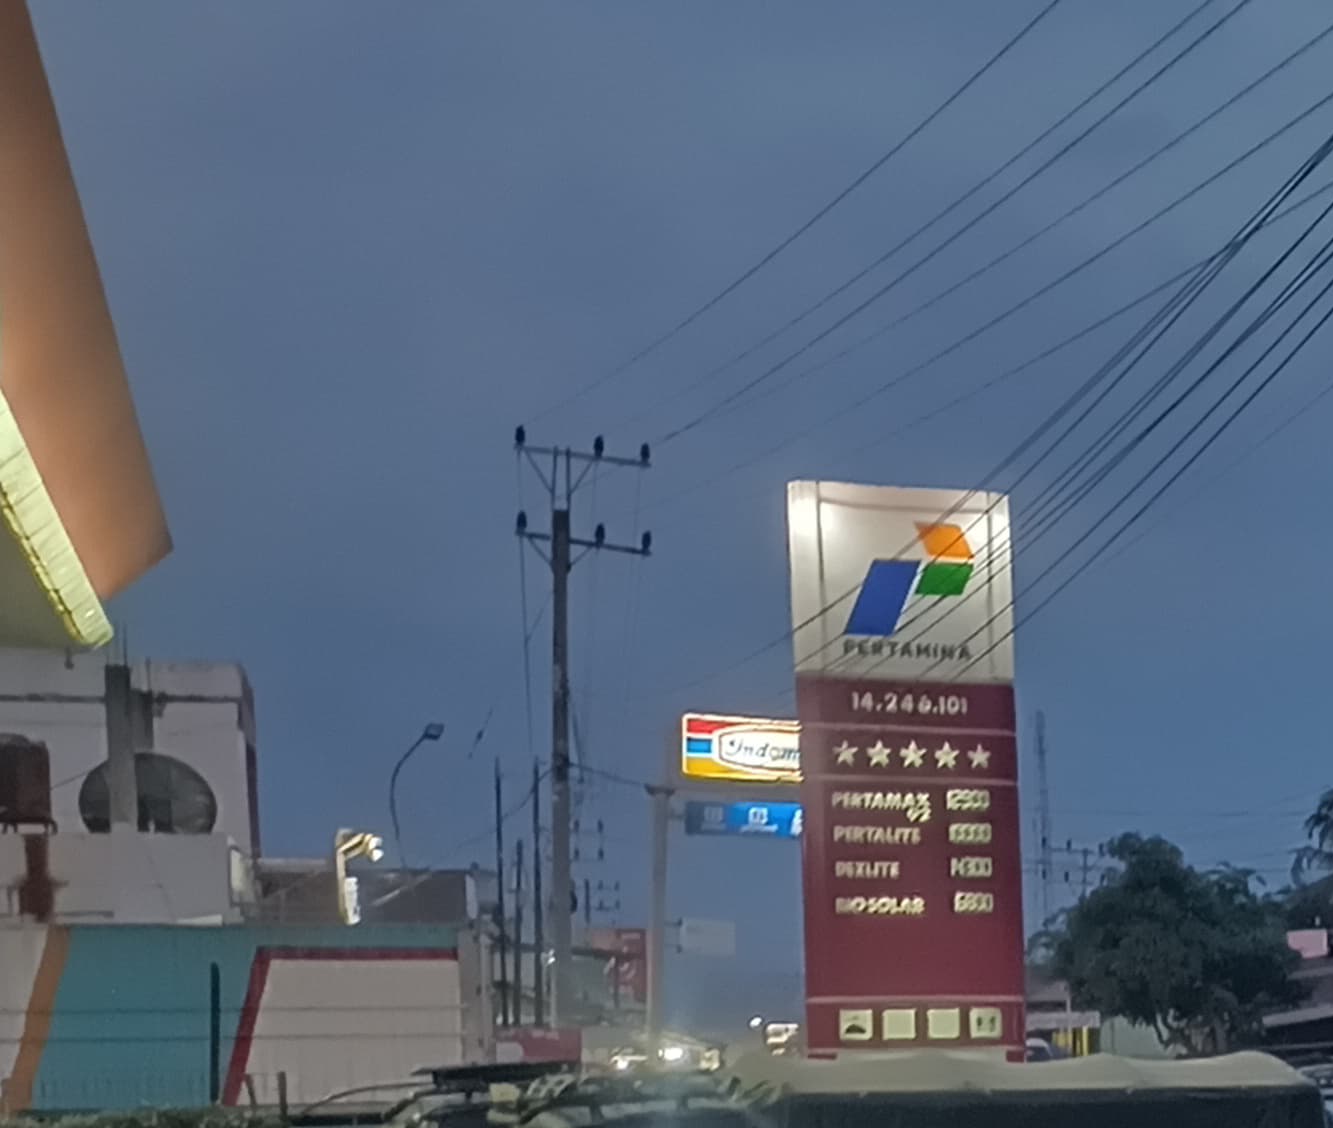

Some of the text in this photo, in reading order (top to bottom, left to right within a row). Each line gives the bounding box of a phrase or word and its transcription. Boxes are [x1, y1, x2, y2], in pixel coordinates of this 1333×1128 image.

[843, 639, 971, 660] PERTAMINA
[832, 791, 931, 810] PERTAMAX
[833, 825, 921, 844] PERTALITE
[835, 860, 900, 878] DEXLITE
